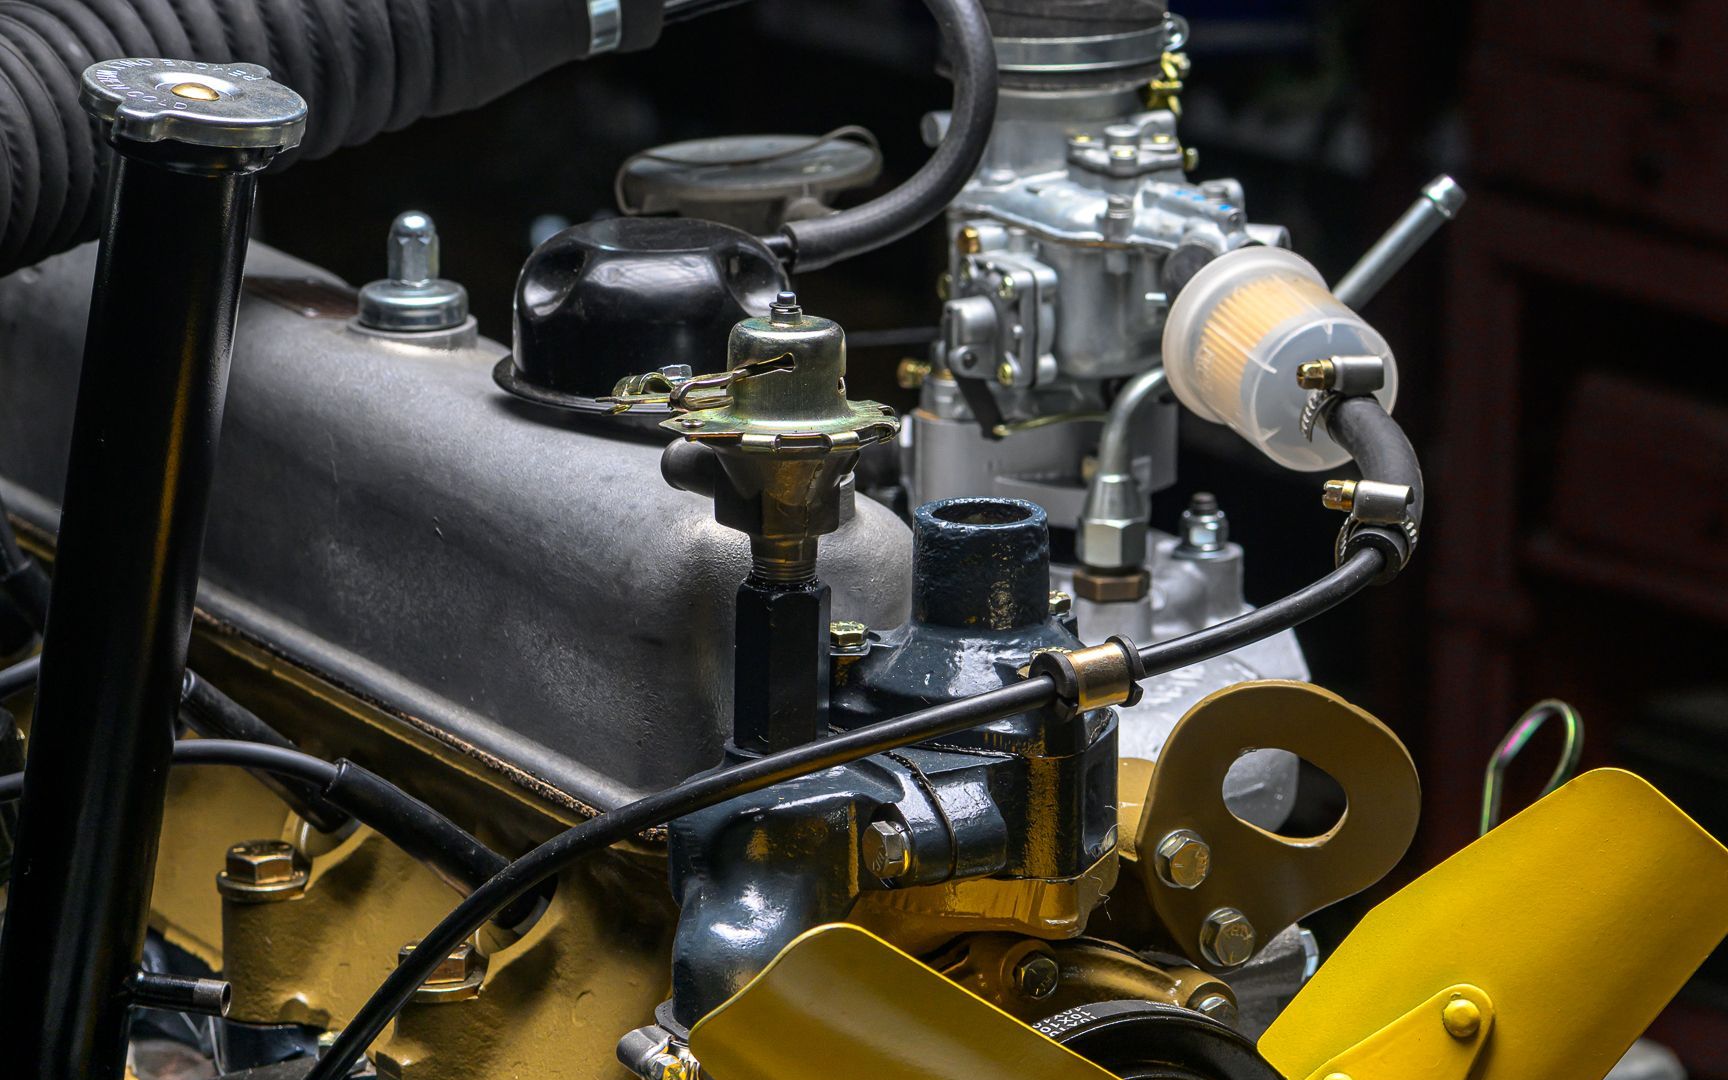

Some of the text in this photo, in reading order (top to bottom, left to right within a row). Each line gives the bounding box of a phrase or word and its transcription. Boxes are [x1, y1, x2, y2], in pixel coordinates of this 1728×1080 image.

[105, 58, 154, 72] ONLY
[96, 69, 131, 91] WHEN
[126, 90, 188, 110] COLD
